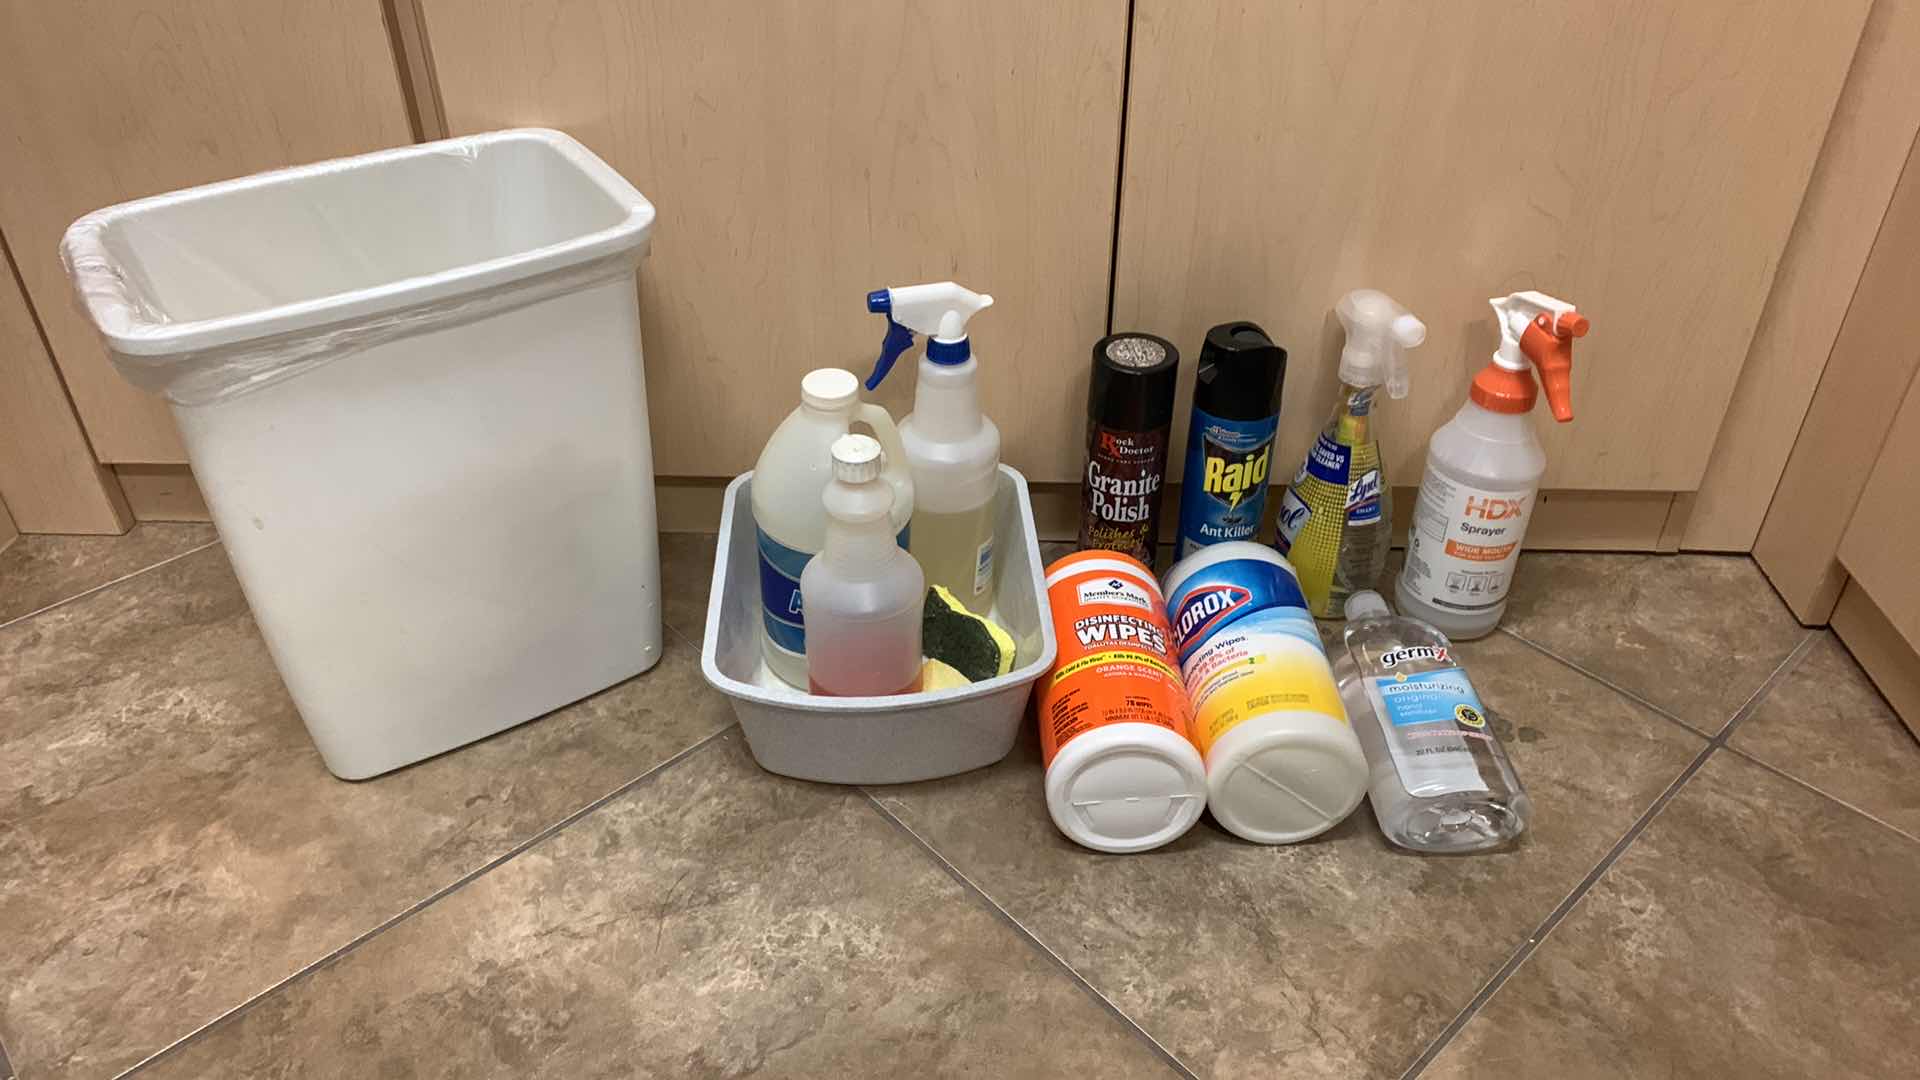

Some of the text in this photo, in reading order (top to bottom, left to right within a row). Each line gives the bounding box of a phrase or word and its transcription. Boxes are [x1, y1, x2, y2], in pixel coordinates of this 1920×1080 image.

[1119, 446, 1155, 456] Doctor
[1088, 460, 1161, 496] Granite
[1203, 444, 1270, 493] Raid
[1091, 489, 1150, 522] Polish
[1464, 495, 1525, 520] HDX
[1200, 523, 1254, 538] Ant Killer
[1460, 522, 1506, 537] Sprayer
[1084, 589, 1125, 598] Member's
[1077, 623, 1167, 656] WIPES
[1389, 681, 1465, 695] moisturizing
